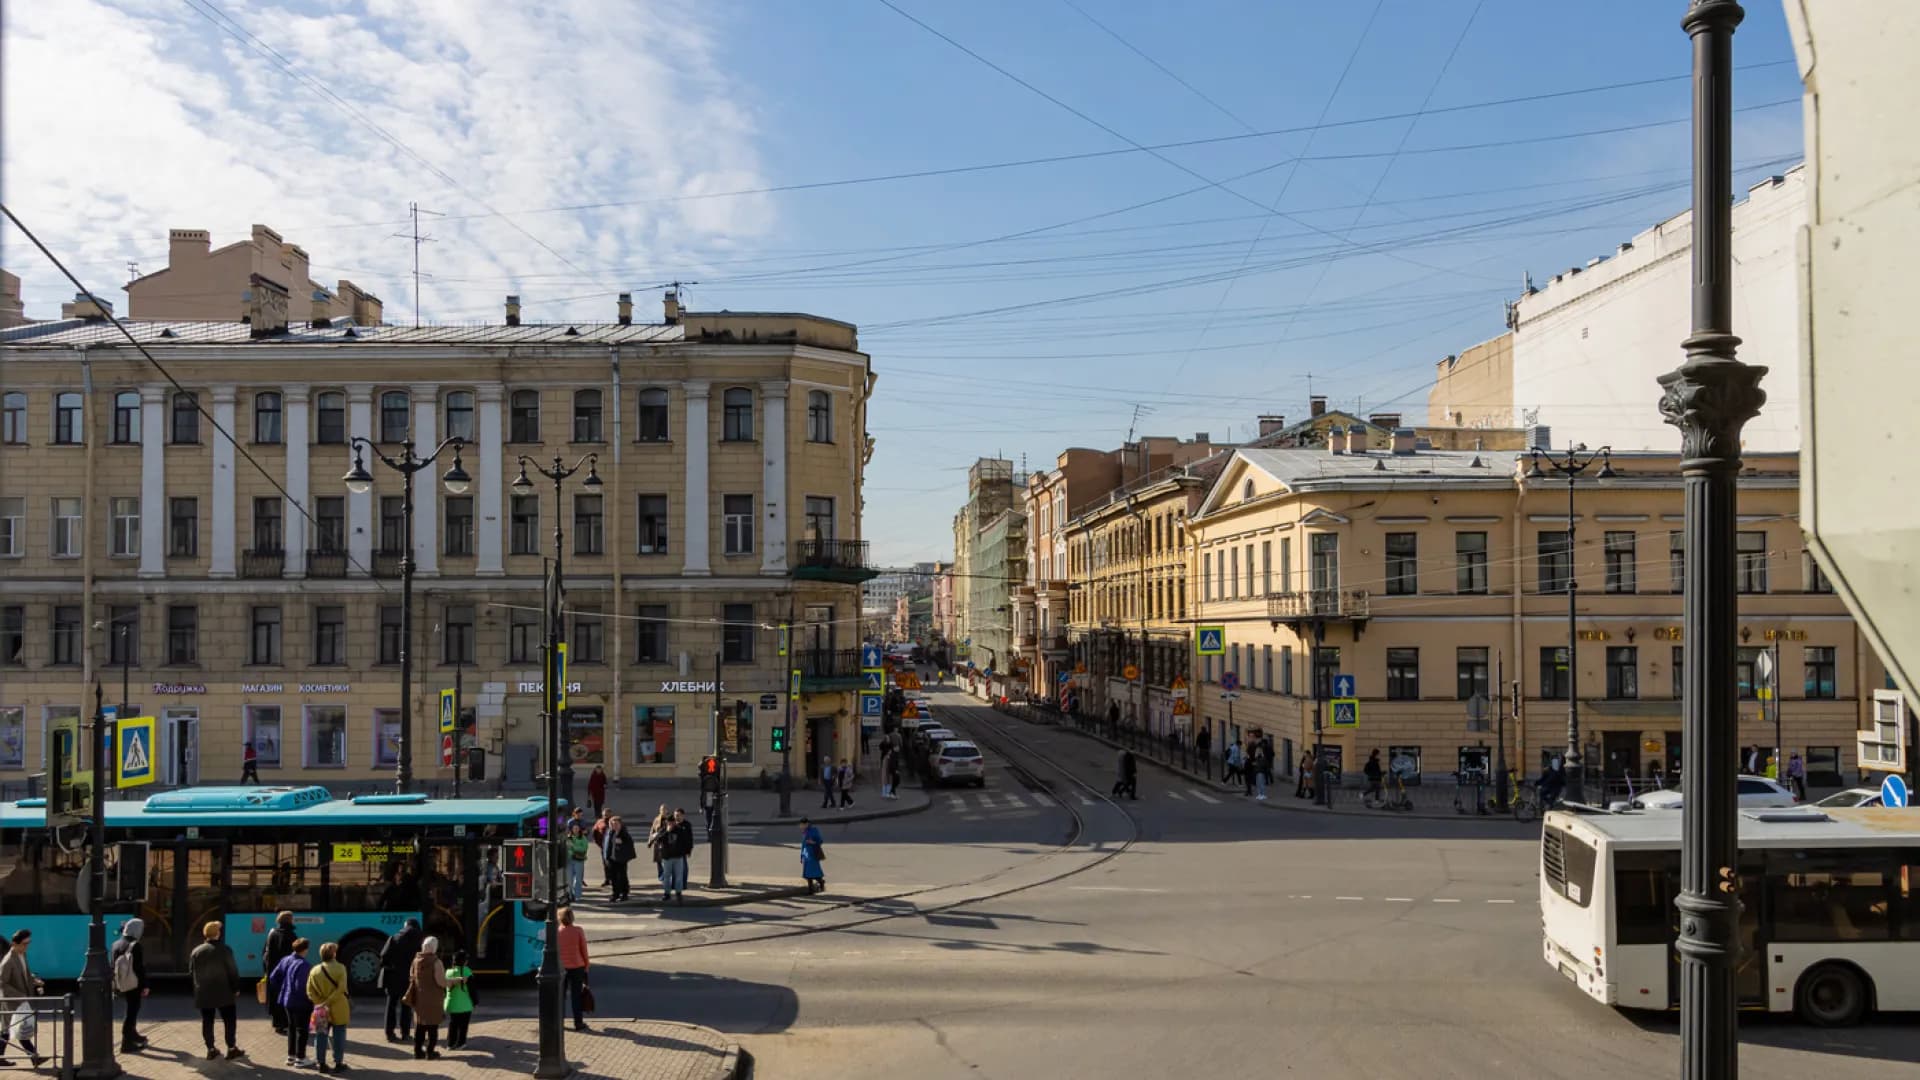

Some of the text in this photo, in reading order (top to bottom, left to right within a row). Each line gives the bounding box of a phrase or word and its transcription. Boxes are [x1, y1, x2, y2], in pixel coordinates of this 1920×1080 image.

[241, 683, 350, 693] МАГАЗИН КОСМЕТИКИ
[519, 682, 581, 693] ПЕКНЯ
[661, 681, 725, 692] ХЛЕБНИК
[340, 848, 354, 858] 26
